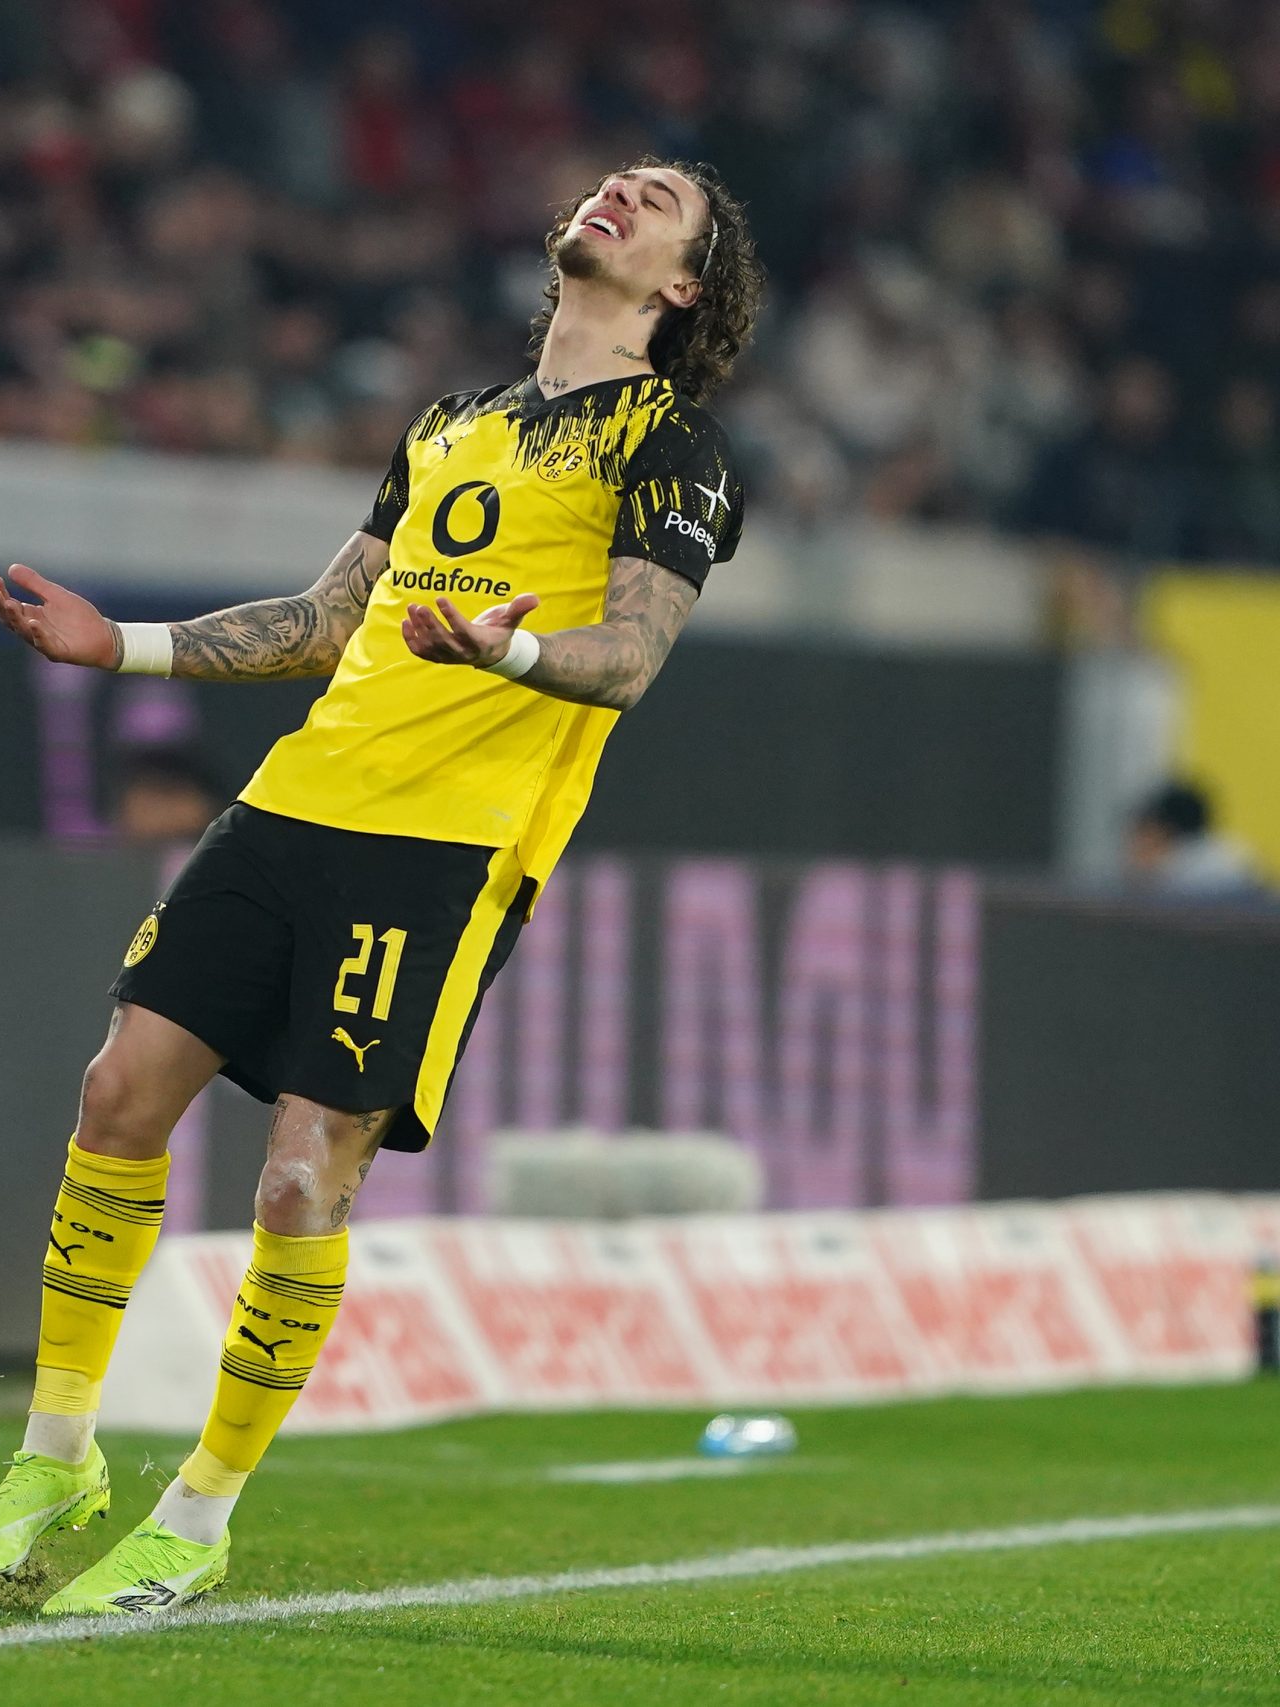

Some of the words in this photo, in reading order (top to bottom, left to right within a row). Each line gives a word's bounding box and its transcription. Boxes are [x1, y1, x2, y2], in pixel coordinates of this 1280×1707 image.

[543, 444, 583, 472] BVB
[664, 510, 717, 562] Polesta
[392, 566, 511, 597] vodafone
[333, 923, 408, 1021] 21
[236, 1293, 272, 1321] BVB
